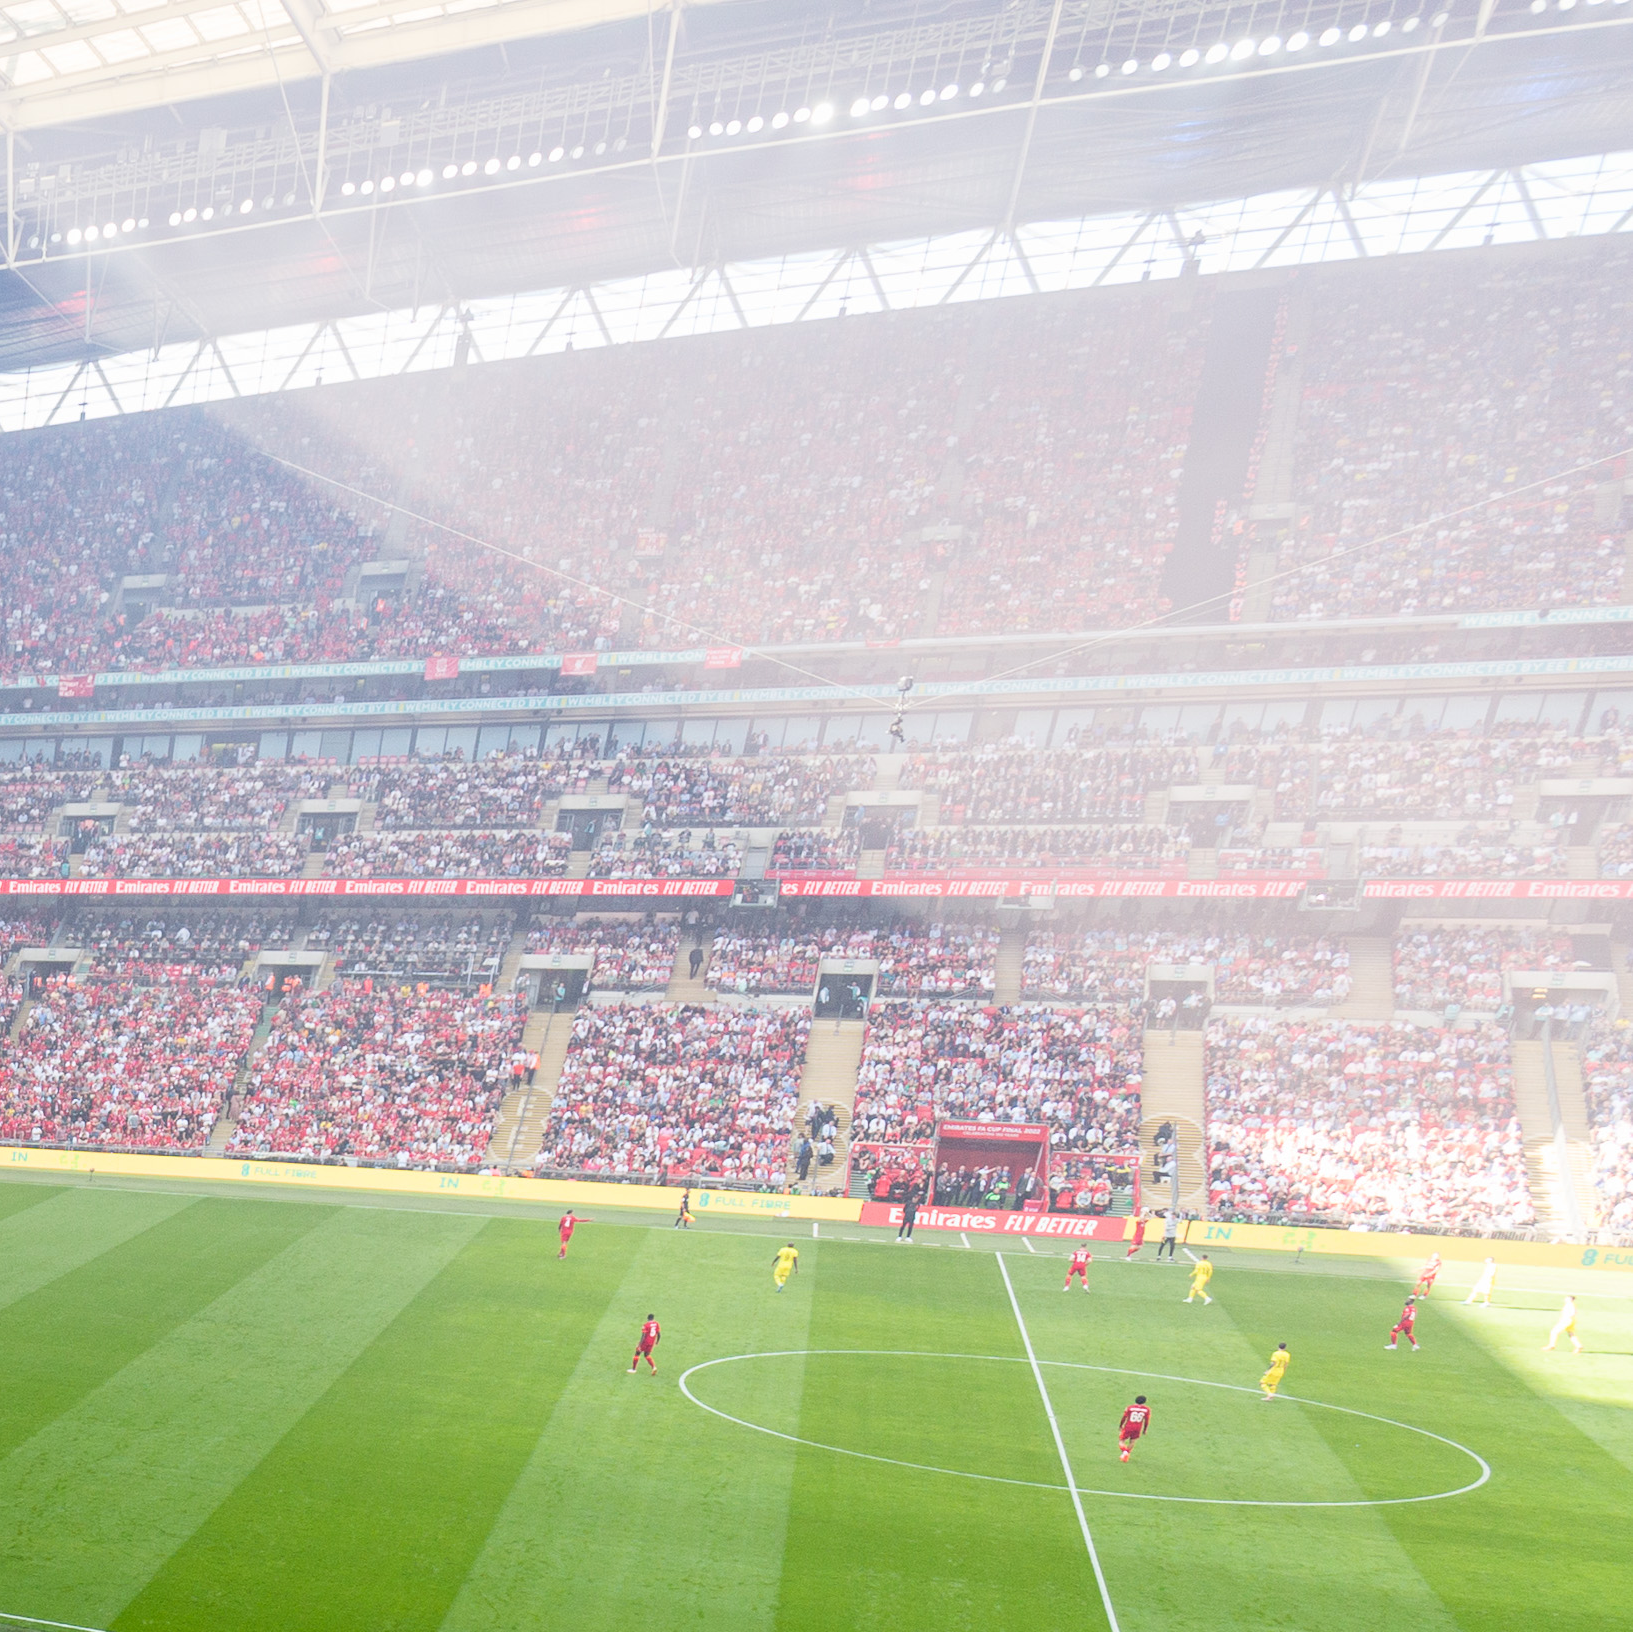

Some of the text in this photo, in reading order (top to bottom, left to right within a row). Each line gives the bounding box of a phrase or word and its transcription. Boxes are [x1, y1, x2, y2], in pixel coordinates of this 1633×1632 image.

[1421, 659, 1565, 675] CONNECTED BY EE
[116, 880, 219, 894] Emirates FLY BETTER
[593, 880, 718, 895] Emirates FLY BETTER
[942, 1123, 977, 1133] EMIRATES
[977, 1125, 986, 1133] FA
[1002, 1126, 1023, 1134] FINAL
[1023, 1127, 1041, 1135] 2022
[439, 1177, 460, 1190] IN
[715, 1195, 791, 1211] FULL FIBRE
[1004, 1215, 1034, 1231] FLY
[1036, 1215, 1098, 1236] BETTER
[1204, 1226, 1233, 1240] IN
[1129, 1411, 1143, 1423] 66
